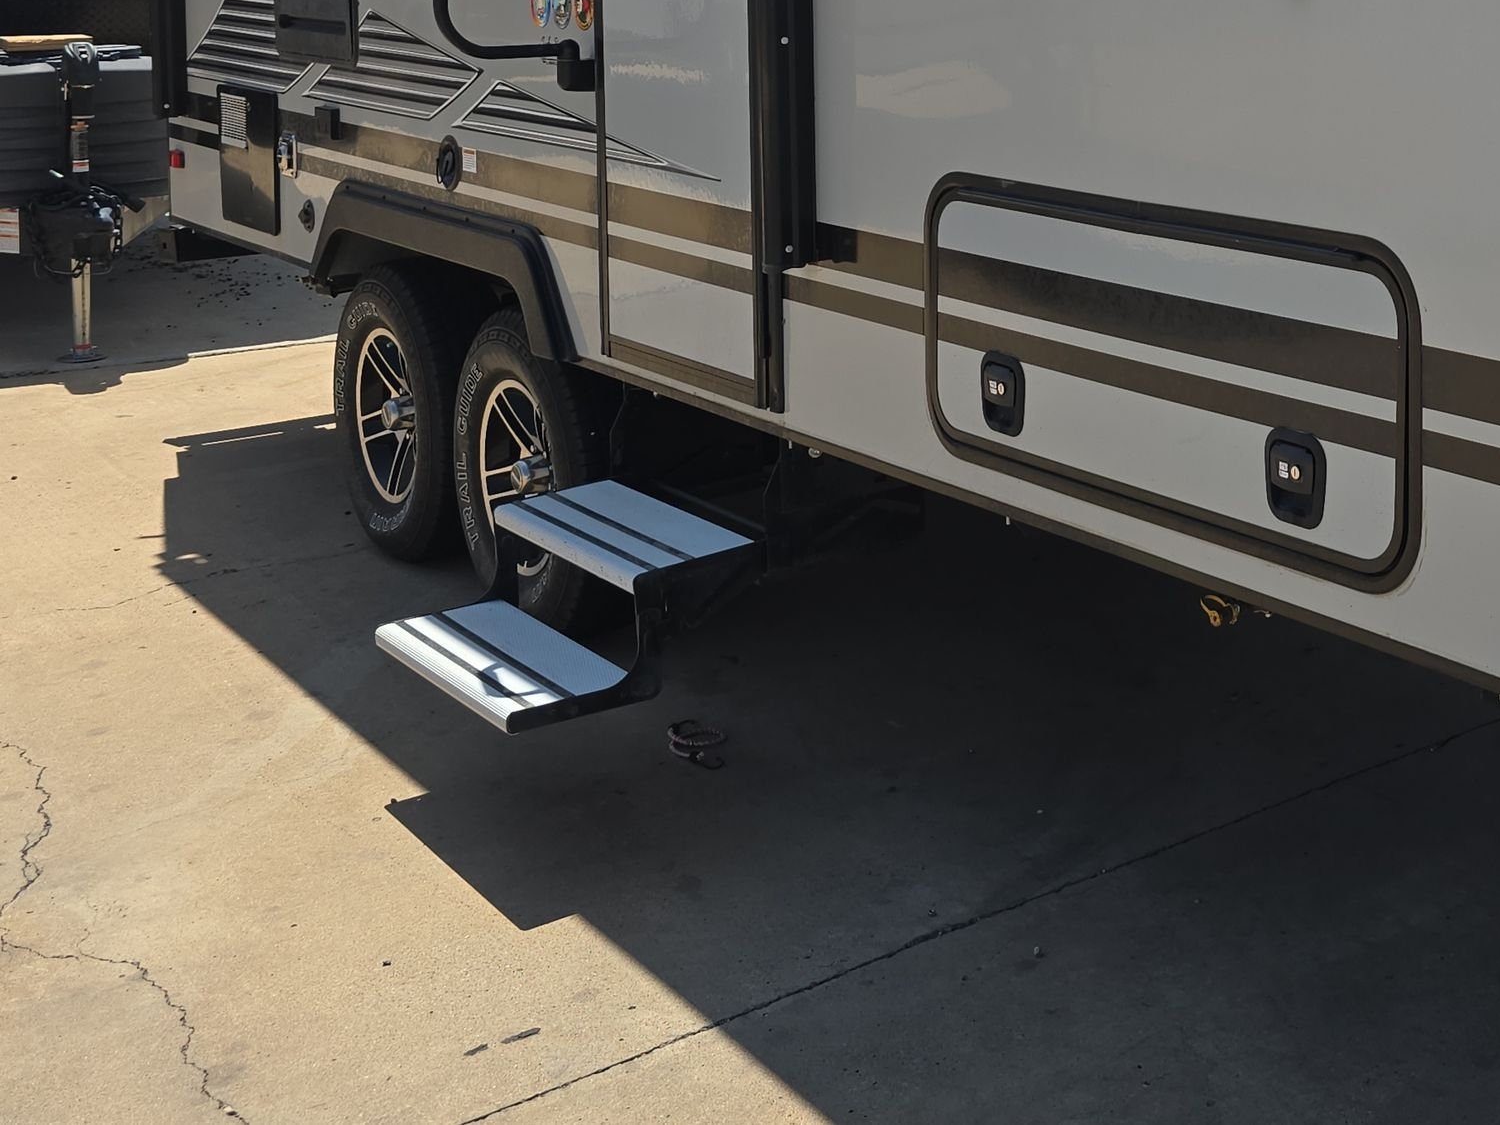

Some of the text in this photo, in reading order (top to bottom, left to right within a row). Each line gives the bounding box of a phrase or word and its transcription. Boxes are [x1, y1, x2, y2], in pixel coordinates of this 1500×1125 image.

[336, 338, 351, 416] TRAIL
[456, 362, 484, 551] TRAIL GUIDE
